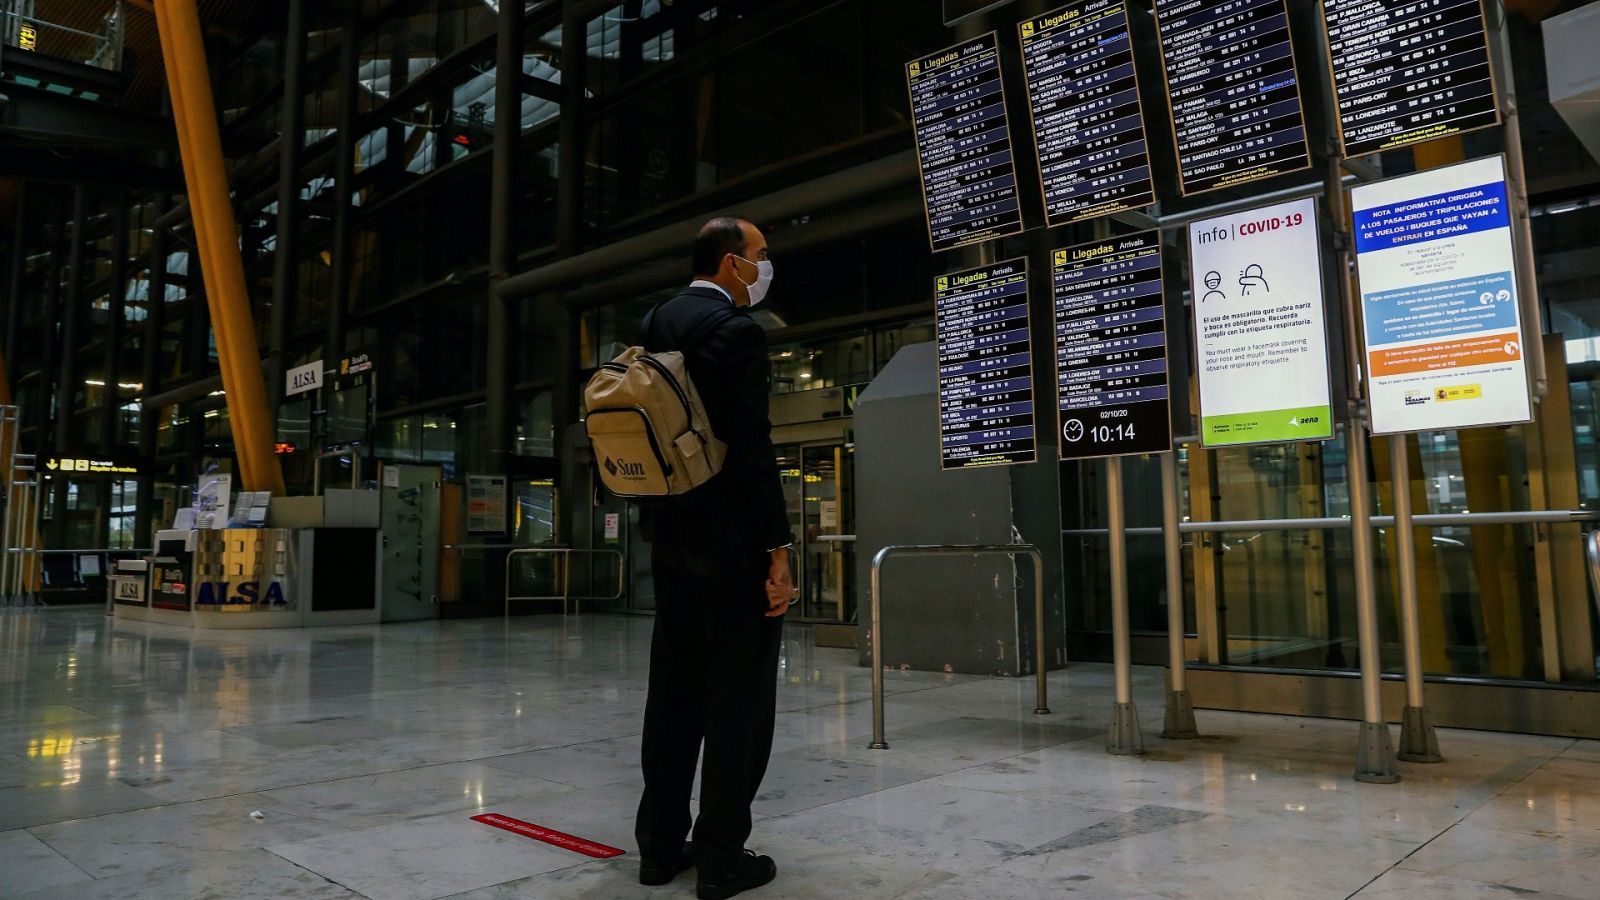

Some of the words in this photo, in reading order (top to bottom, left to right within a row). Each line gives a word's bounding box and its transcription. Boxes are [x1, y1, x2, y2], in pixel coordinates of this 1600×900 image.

[1040, 9, 1080, 29] Llegadas
[1085, 0, 1108, 12] Arrivals
[1170, 1, 1202, 15] SANTANDER
[1340, 1, 1381, 17] P.MALLORCA
[1171, 20, 1187, 29] VIENA
[1342, 22, 1360, 32] GRAN
[1361, 14, 1389, 27] CANARIA
[1174, 25, 1214, 42] GRANADA-JAEN
[1344, 34, 1374, 47] TENERIFE
[1374, 27, 1397, 38] NORTE
[924, 52, 959, 69] Llegadas
[963, 43, 983, 55] Arrivals
[1176, 43, 1201, 55] ALICANTE
[1347, 48, 1379, 62] MENORCA
[1037, 61, 1067, 73] CASABLANCA
[1178, 57, 1201, 68] ALMERIA
[1039, 75, 1063, 86] MARSELLA
[1180, 68, 1211, 82] HAMBURGO
[1182, 84, 1204, 95] SEVILLA
[1351, 79, 1376, 91] MEXICO
[1376, 75, 1392, 84] CITY
[1184, 98, 1206, 108] PANAMA
[1353, 92, 1388, 105] PARIS-ORY
[1186, 111, 1208, 121] MALAGA
[1355, 105, 1397, 120] LONDRES-HR
[1188, 123, 1215, 134] SANTIAGO
[1358, 121, 1396, 135] LANZAROTE
[1190, 136, 1218, 147] PARIS-ORY
[1192, 150, 1219, 162] SANTIAGO
[1220, 146, 1236, 154] CHILE
[1206, 163, 1224, 172] PAULO
[1053, 173, 1078, 183] PARIS-ORY
[1057, 200, 1076, 208] MELILLA
[1372, 210, 1391, 218] NOTA
[1395, 198, 1446, 213] INFORMATIVA
[1448, 190, 1483, 203] DIRIGIDA
[1384, 212, 1427, 225] PASAJEROS
[1436, 198, 1500, 215] TRIPULACIONES
[1198, 227, 1227, 244] info
[1240, 213, 1303, 236] COVID-19
[1376, 225, 1405, 237] VUELOS
[1410, 218, 1442, 230] BUQUES
[1444, 216, 1459, 224] QUE
[1462, 210, 1488, 220] VAYAN
[1392, 233, 1422, 243] ENTRAR
[1424, 230, 1434, 238] EN
[1437, 224, 1468, 235] ESPAÑA
[1072, 245, 1113, 259] Llegadas
[1120, 239, 1144, 249] Arrivals
[953, 272, 987, 285] Llegadas
[992, 267, 1013, 276] Arrivals
[1075, 281, 1100, 290] SEBASTIAN
[1066, 307, 1096, 316] LONDRES-HR
[1231, 310, 1261, 319] mascarilla
[1263, 308, 1274, 316] que
[1276, 305, 1293, 313] cubra
[1295, 302, 1311, 310] nariz
[1233, 317, 1267, 327] obligatorio.
[1268, 313, 1298, 321] Recuerda
[1204, 331, 1226, 340] cumplir
[1246, 324, 1272, 333] etiqueta
[1274, 319, 1312, 329] respiratoria.
[1252, 341, 1280, 350] facemask
[1281, 338, 1307, 347] covering
[1268, 348, 1298, 357] Remember
[1206, 364, 1228, 372] observe
[1230, 361, 1260, 369] respiratory
[293, 370, 316, 388] ALSA
[1100, 410, 1127, 419] 02/10/20
[1091, 423, 1135, 443] 10:14
[617, 459, 646, 475] Sun
[120, 583, 138, 599] ALSA
[195, 581, 287, 605] ALSA
